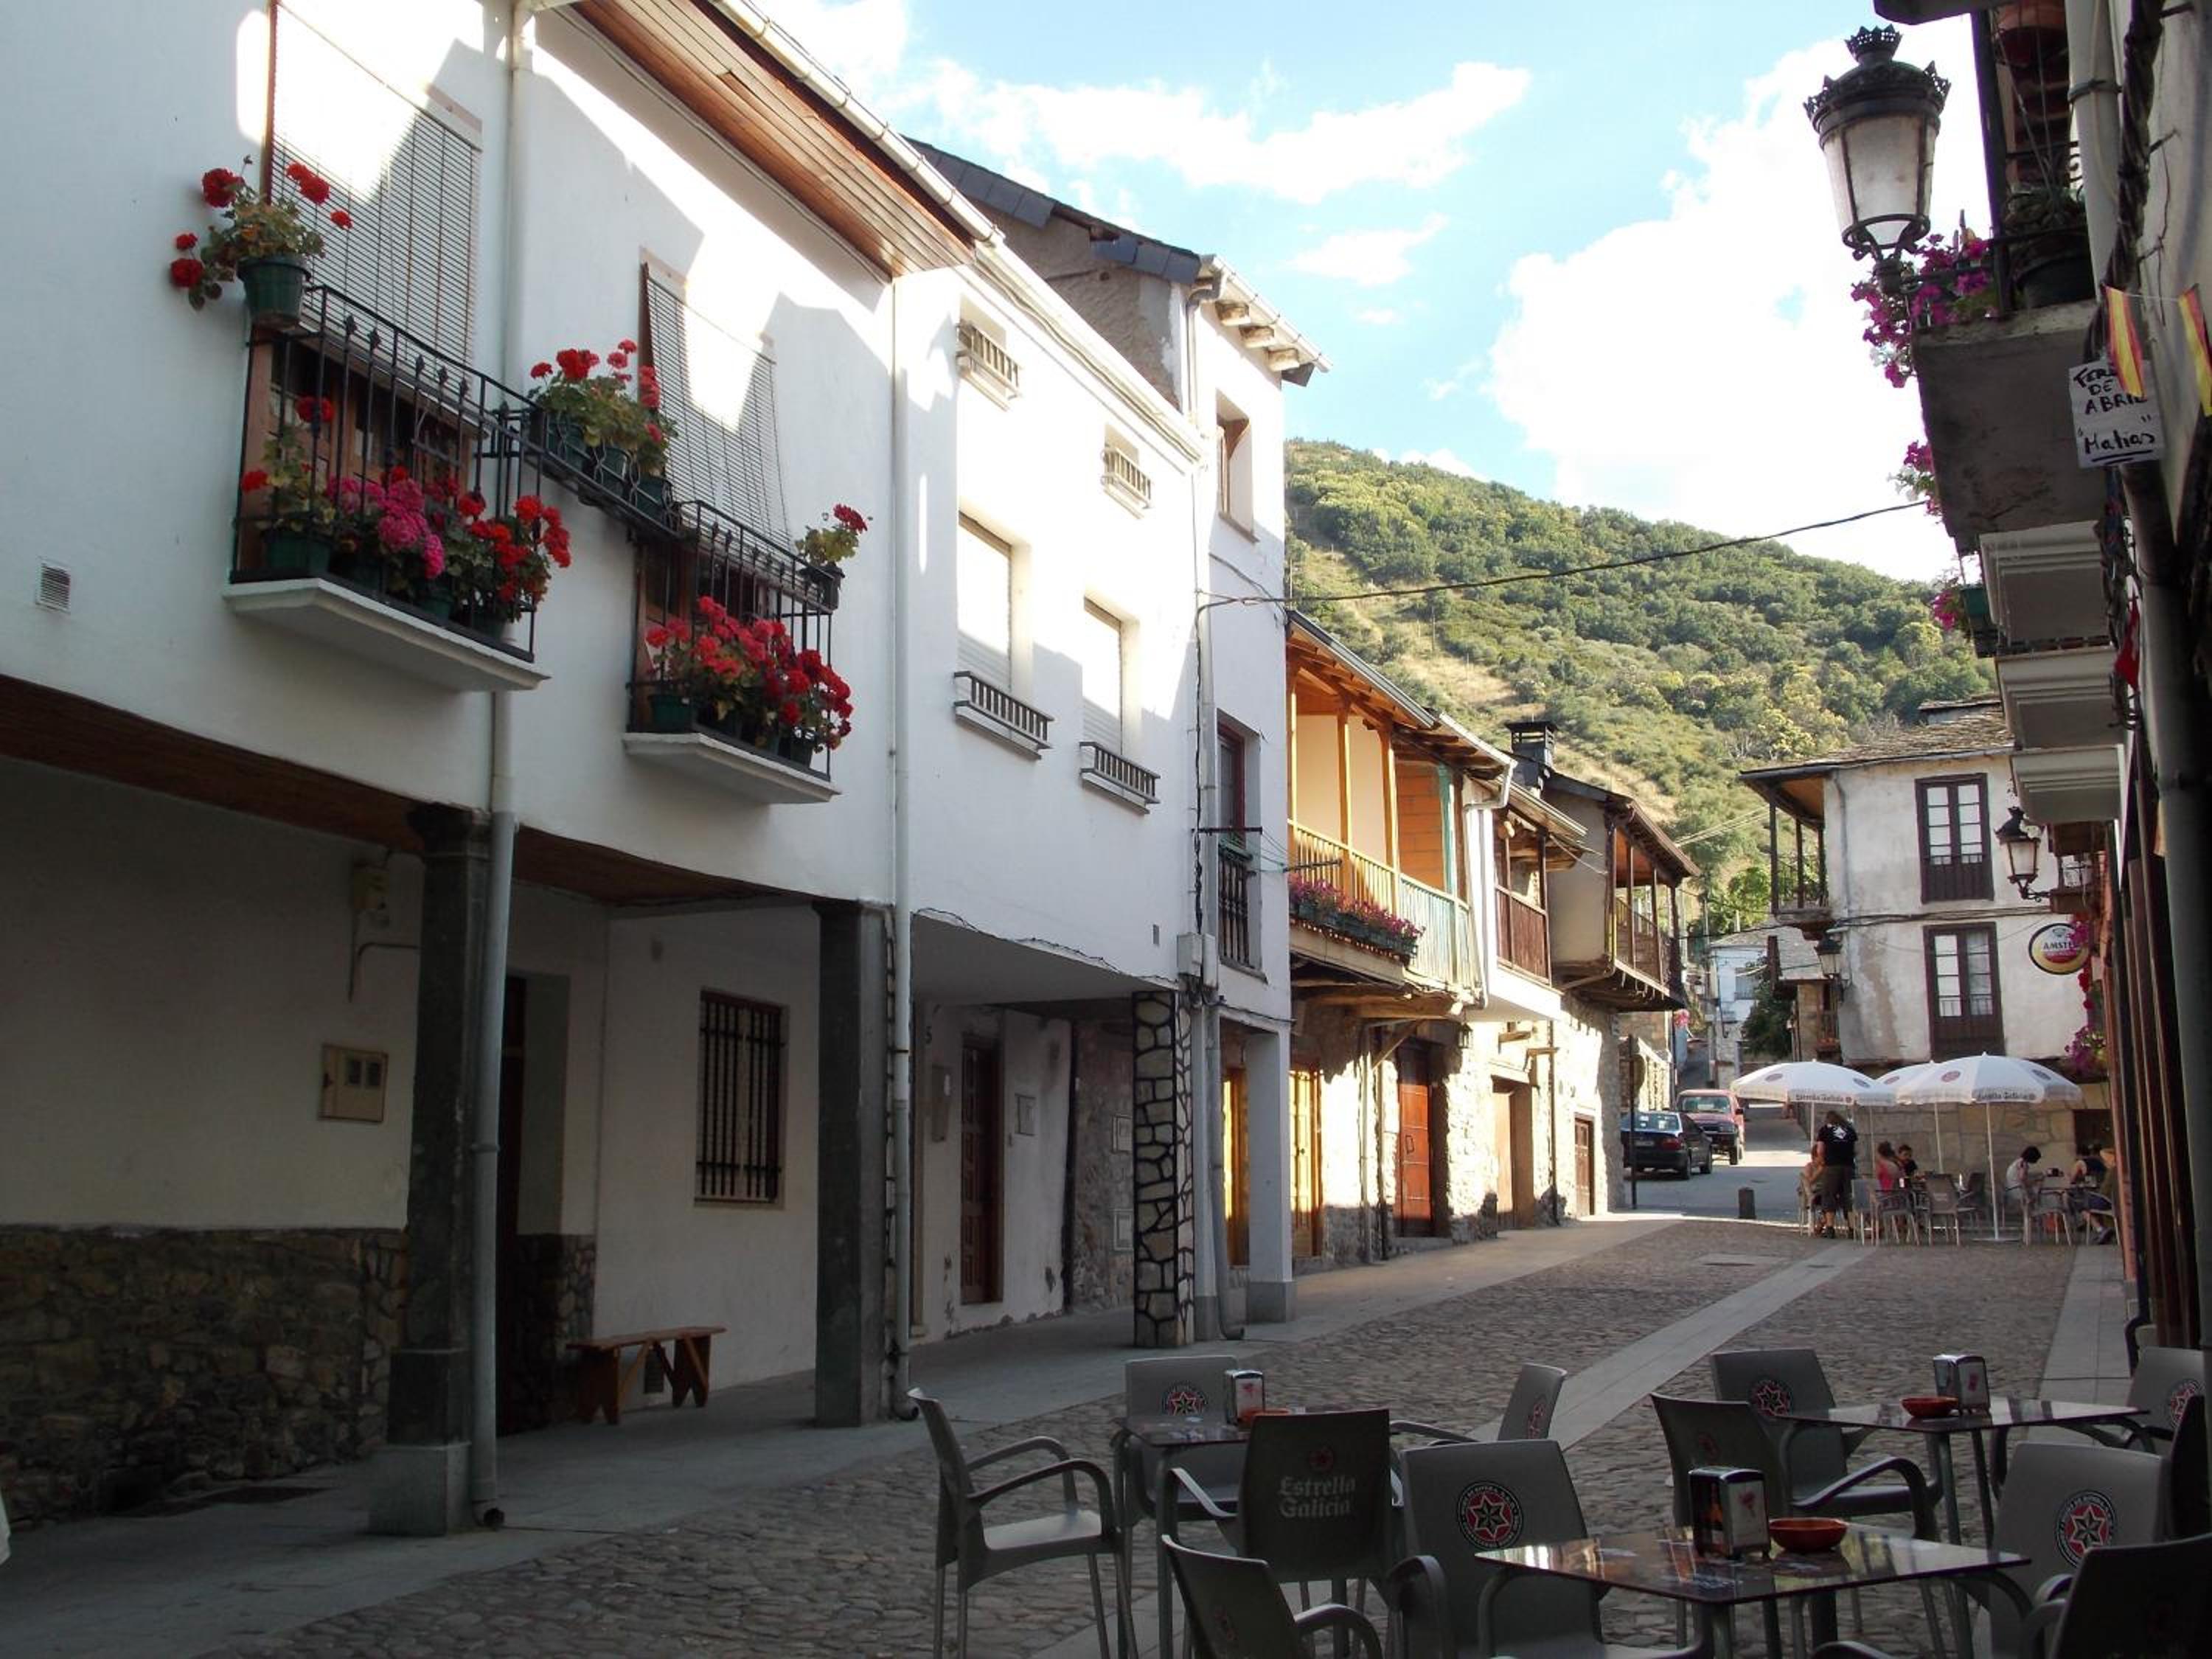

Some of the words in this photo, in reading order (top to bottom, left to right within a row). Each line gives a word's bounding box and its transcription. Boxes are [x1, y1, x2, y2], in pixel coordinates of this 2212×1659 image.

[2088, 379, 2113, 395] DE
[2085, 392, 2148, 414] ABRIL
[1278, 1475, 1356, 1497] Estrella
[1279, 1496, 1352, 1518] Galicia
